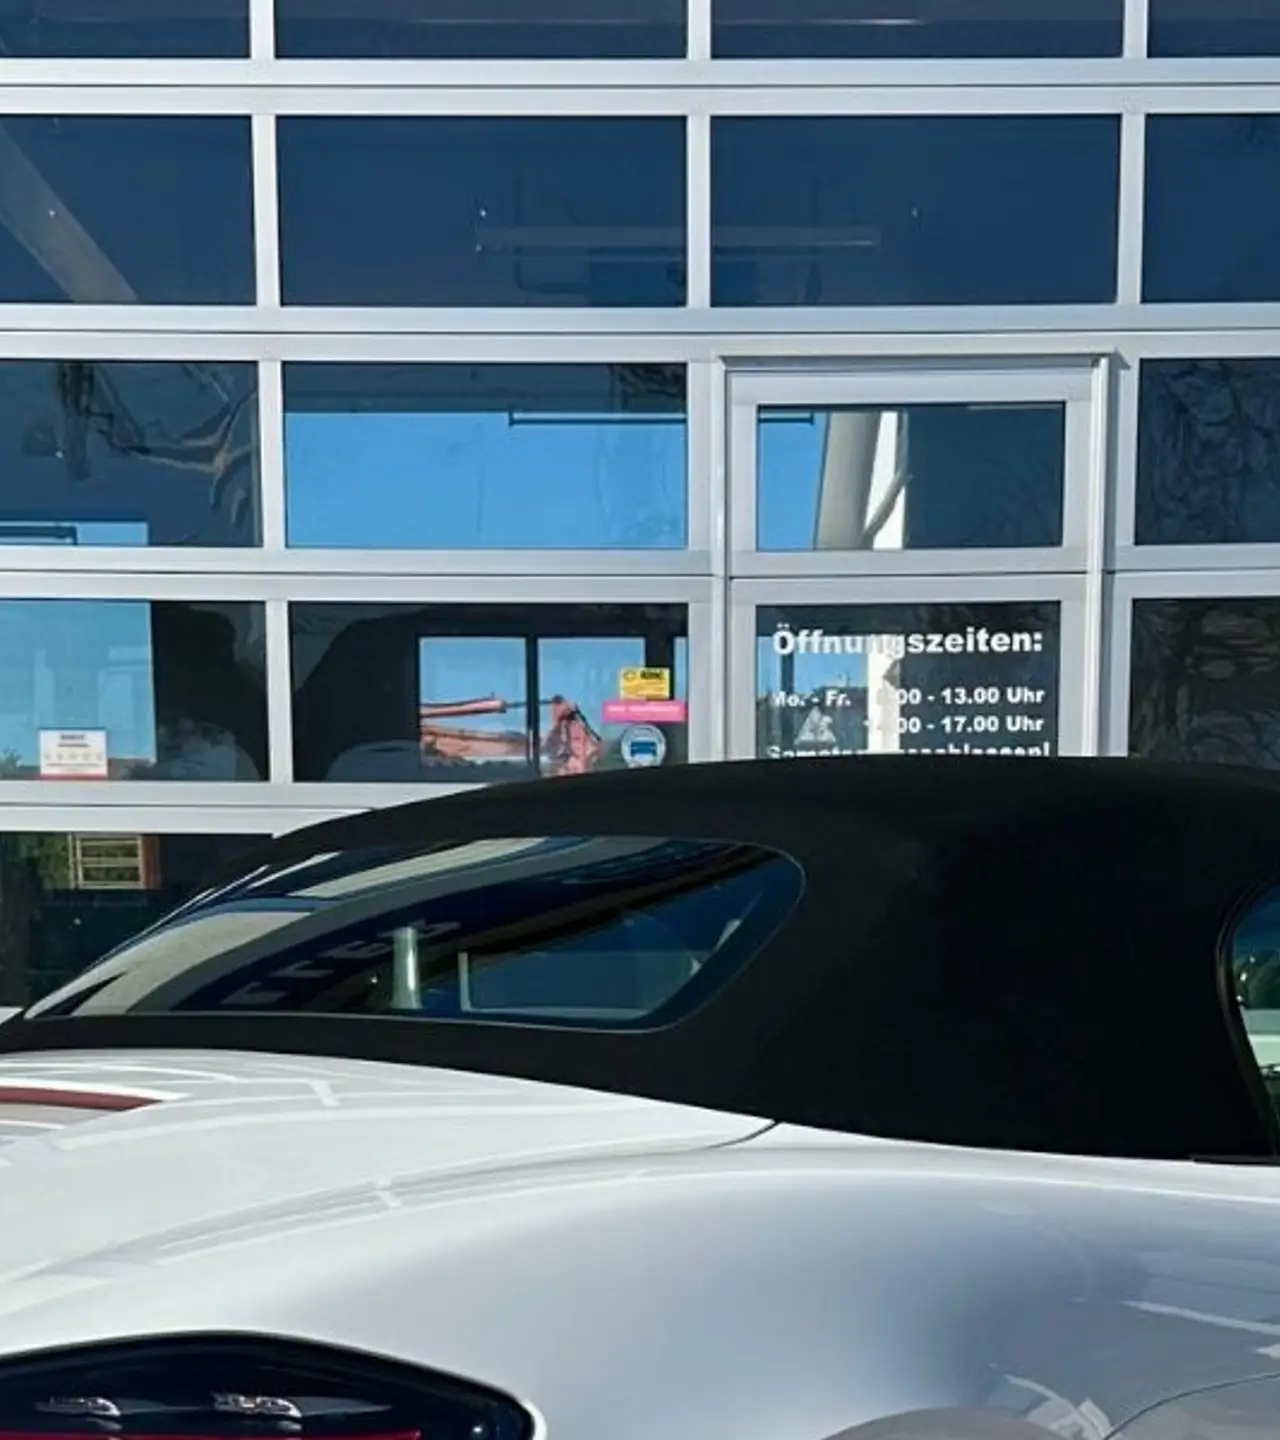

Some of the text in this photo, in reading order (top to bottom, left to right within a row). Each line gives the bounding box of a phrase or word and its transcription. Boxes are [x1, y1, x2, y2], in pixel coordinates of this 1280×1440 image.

[772, 623, 1042, 658] Öffnungszeiten:
[825, 688, 851, 707] Fr.
[940, 686, 1000, 705] 13.00
[1006, 686, 1045, 704] Uhr
[940, 714, 1000, 733] 17.00
[1005, 714, 1045, 732] Uhr
